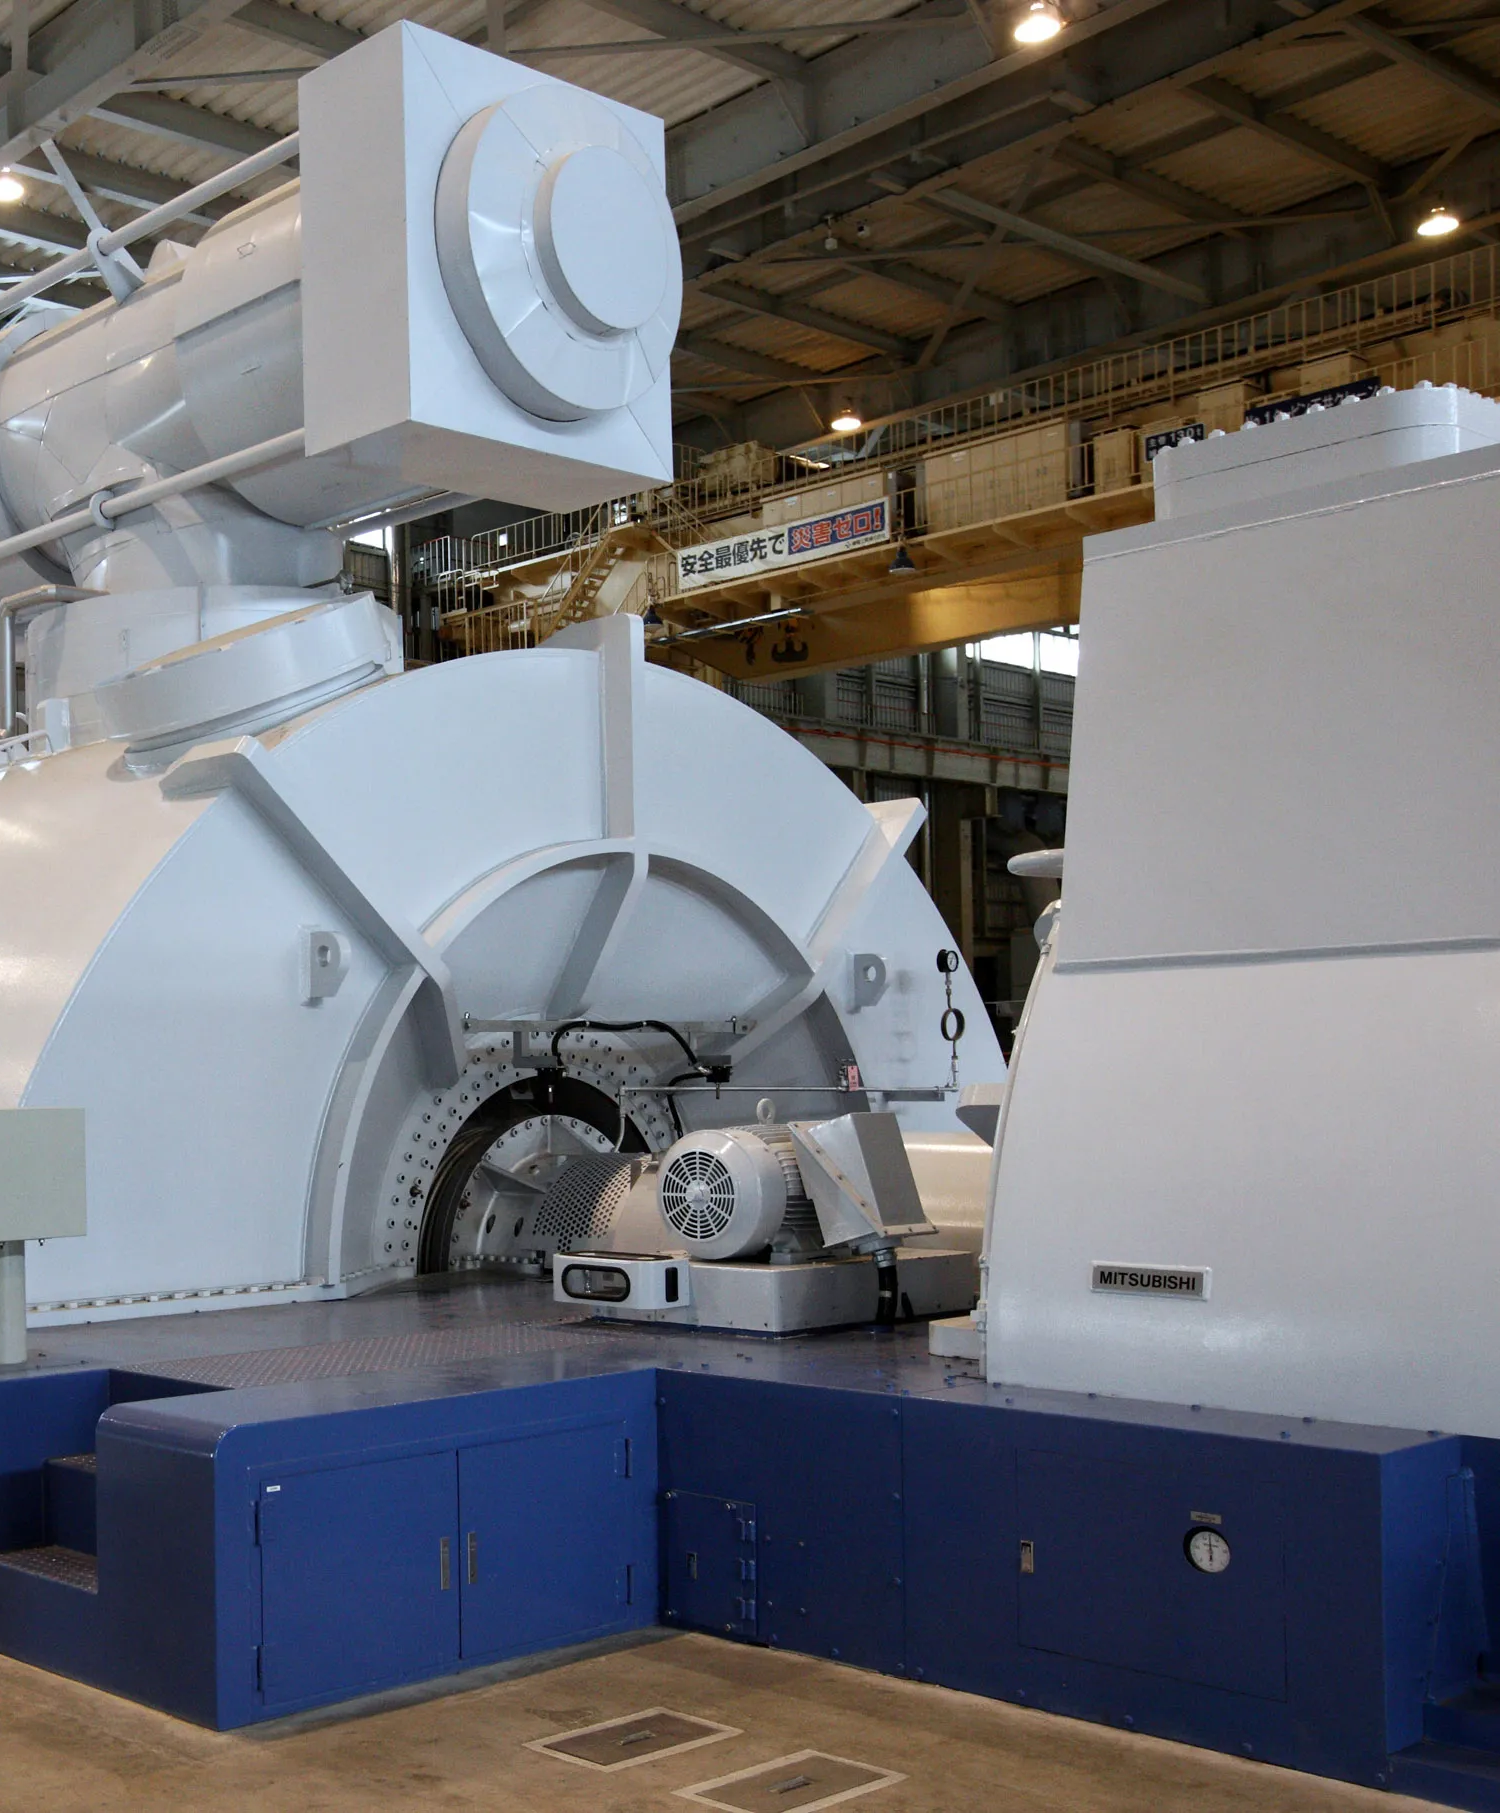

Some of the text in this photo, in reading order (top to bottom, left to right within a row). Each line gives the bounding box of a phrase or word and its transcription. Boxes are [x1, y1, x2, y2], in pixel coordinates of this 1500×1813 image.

[681, 533, 785, 577] 安全最優先で
[1099, 1271, 1196, 1290] MITSUBISHI
